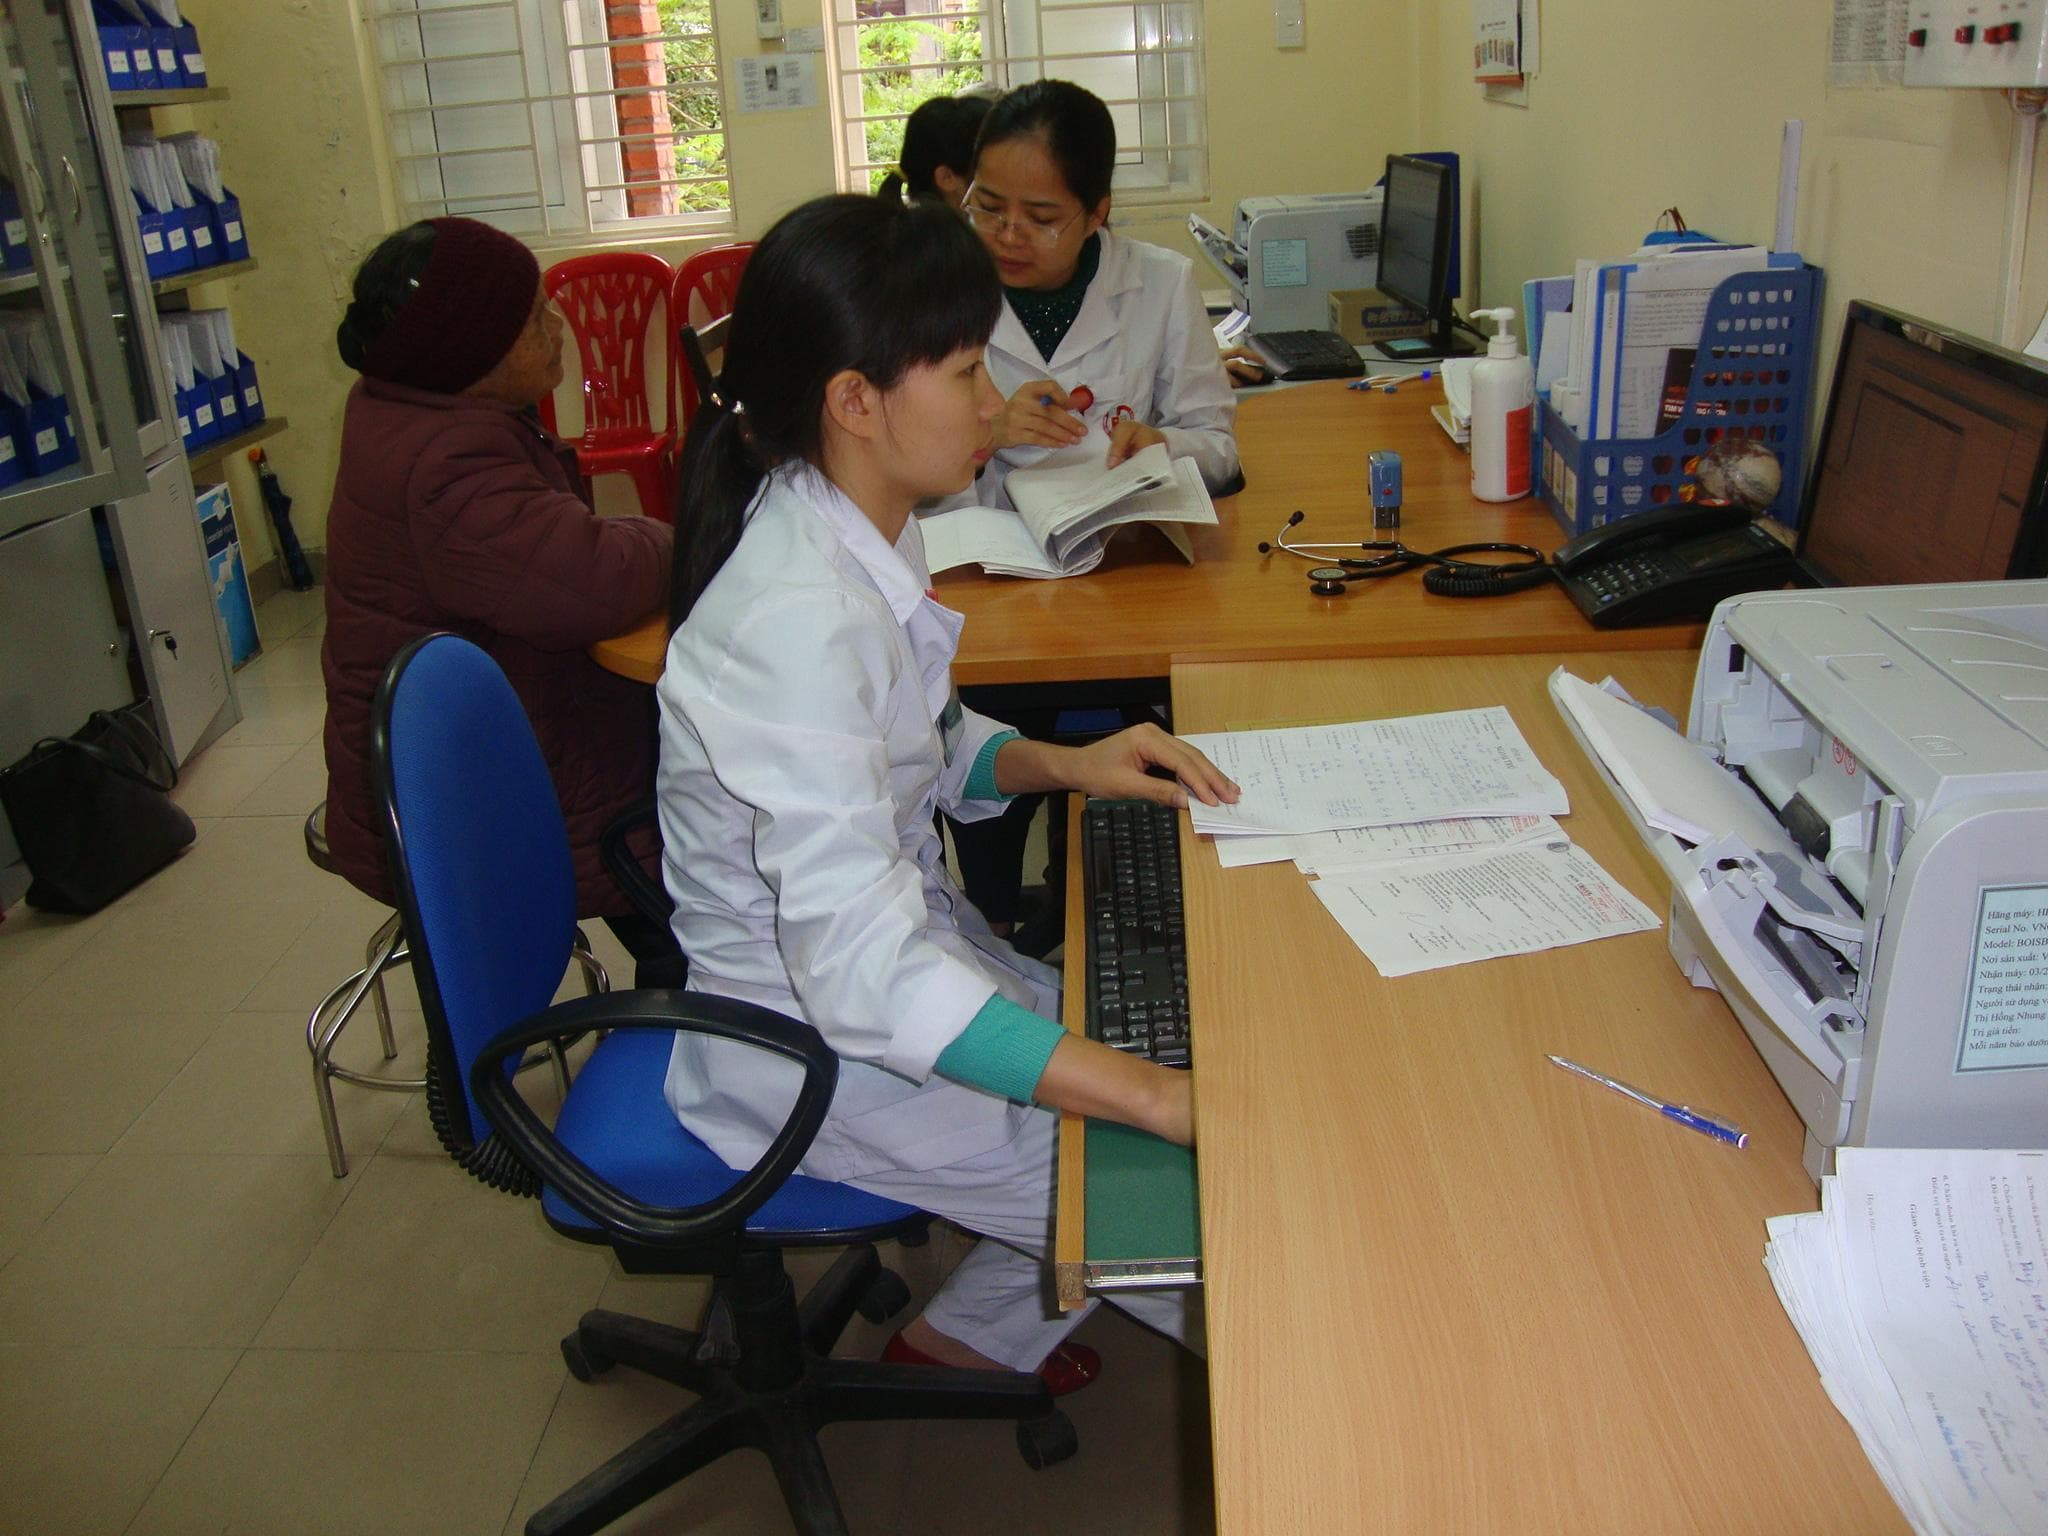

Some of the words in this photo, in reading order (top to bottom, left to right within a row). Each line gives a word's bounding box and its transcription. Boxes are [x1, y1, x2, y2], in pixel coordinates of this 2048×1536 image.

[1985, 924, 2010, 934] Serial
[1983, 940, 2014, 949] Model:
[2017, 1011, 2046, 1021] Nhung
